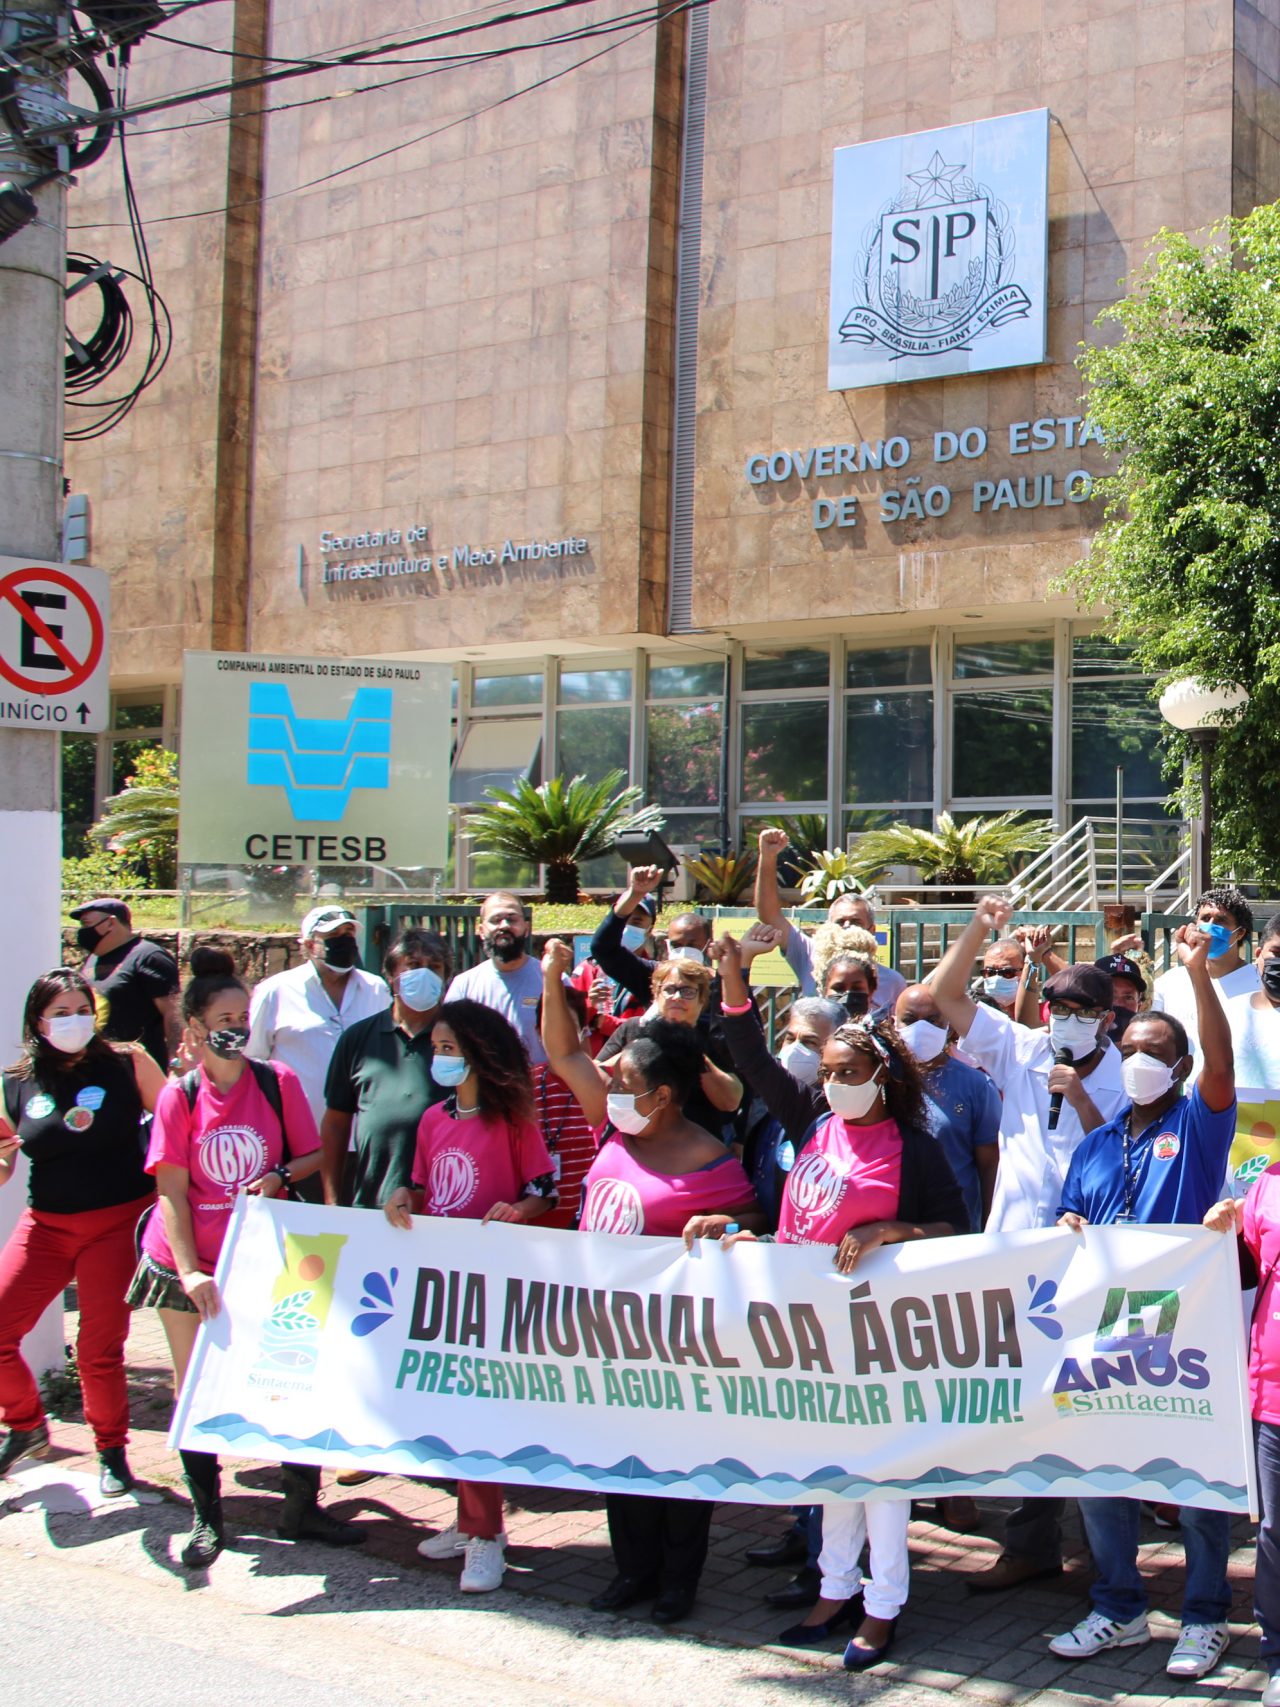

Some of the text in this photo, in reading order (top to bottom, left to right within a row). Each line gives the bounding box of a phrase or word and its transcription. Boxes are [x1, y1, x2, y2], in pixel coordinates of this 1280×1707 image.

[855, 290, 1018, 350] PRO BRASILIA FIANT EXIMIA
[745, 416, 1112, 485] GOVERNO DO ESTA
[812, 469, 1093, 530] DE SÃO PAULO
[320, 525, 427, 553] Secretaria de
[322, 536, 588, 583] Infraestrutura e Meio Ambiente
[217, 659, 421, 680] COMPANHIA AMBIENTAL DO ESTADO DE SÃO PAULO
[0, 699, 68, 722] INÍCIO
[245, 833, 387, 862] CETESB
[201, 1133, 258, 1183] UBM
[408, 1266, 1023, 1375] DIA MUNDIAL DA ÁGUA
[247, 1372, 313, 1392] Sintaema
[395, 1348, 1025, 1425] PRESERVAR A ÁGUA E VALORIZAR A VIDA!
[1053, 1347, 1211, 1394] ANOS
[1071, 1392, 1214, 1416] Sintaema
